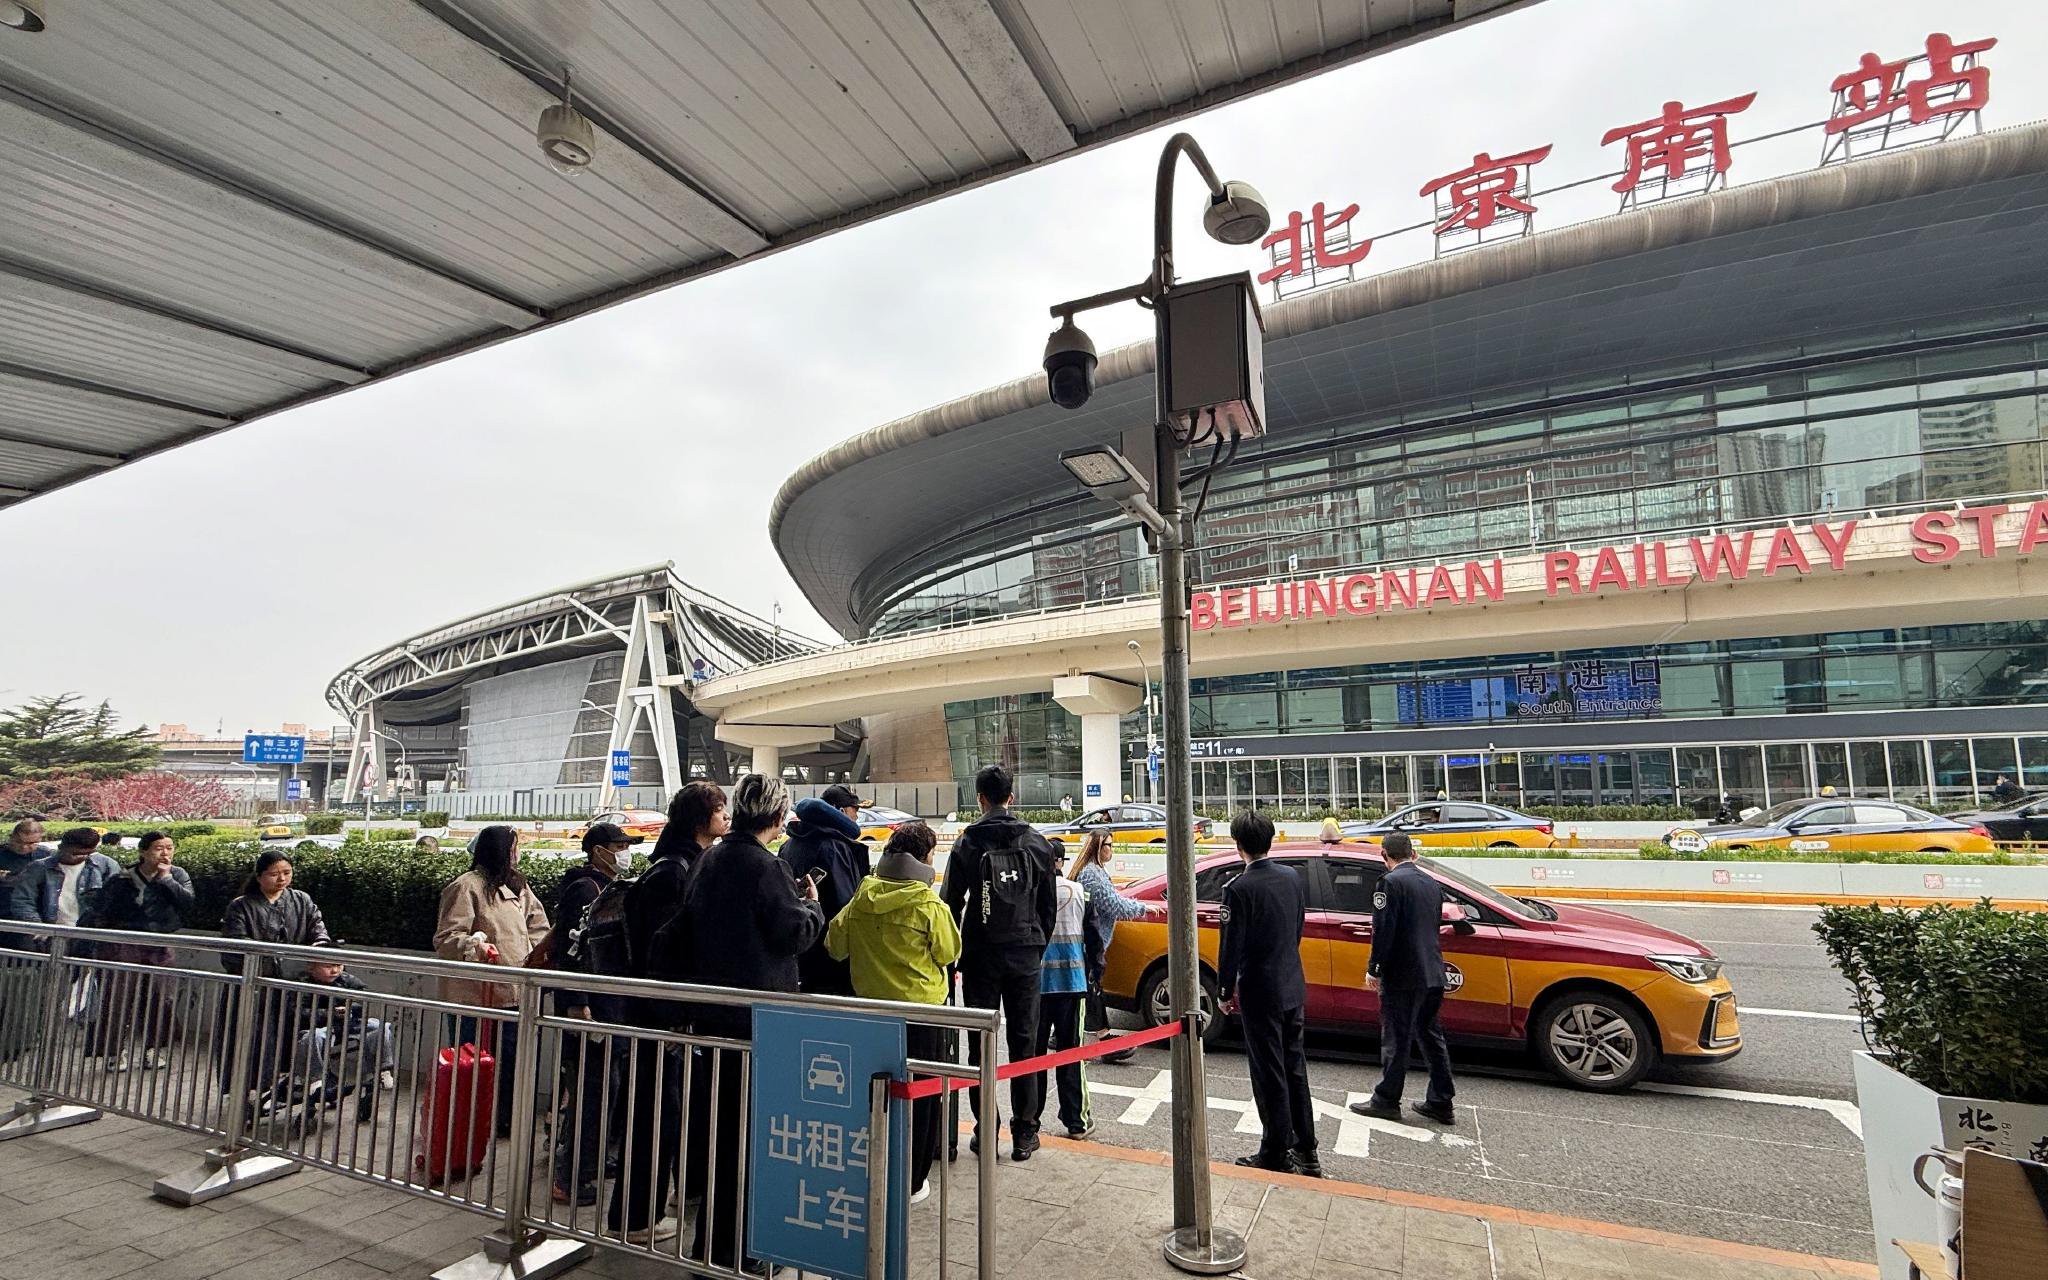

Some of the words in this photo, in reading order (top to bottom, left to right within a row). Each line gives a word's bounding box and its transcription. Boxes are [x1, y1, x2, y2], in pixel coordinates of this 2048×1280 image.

[1258, 33, 1998, 284] 北京南站
[1191, 558, 1504, 631] BEIJINGNAN
[1544, 520, 1858, 597] RAILWAY
[1513, 659, 1662, 695] 南进口
[1518, 700, 1572, 715] South
[1576, 698, 1663, 713] Entrance
[784, 1179, 865, 1239] 上车
